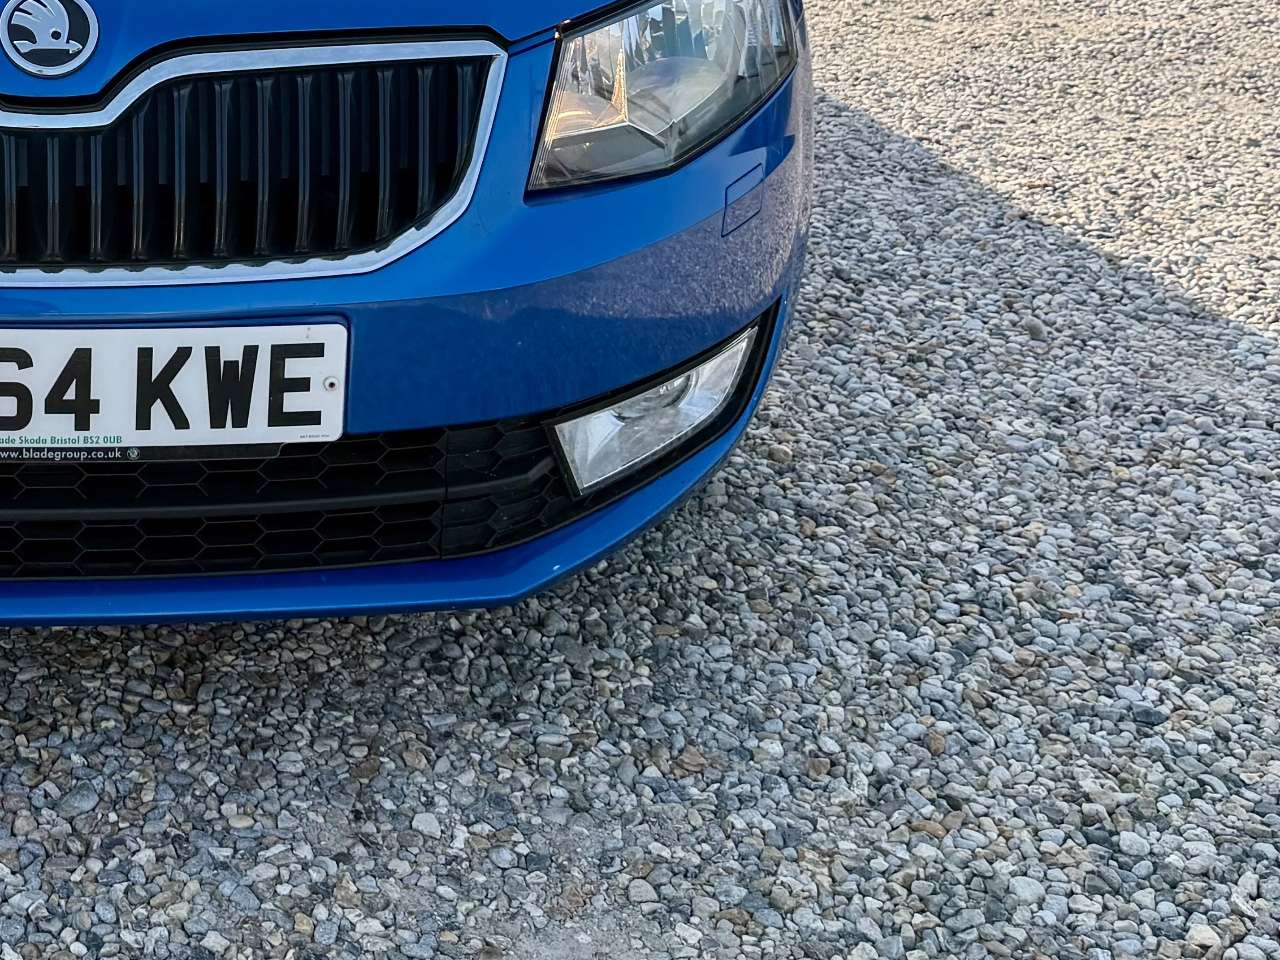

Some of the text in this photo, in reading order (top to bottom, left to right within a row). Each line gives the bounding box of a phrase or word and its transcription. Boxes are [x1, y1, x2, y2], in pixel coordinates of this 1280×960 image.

[135, 342, 325, 432] KWE
[18, 435, 48, 445] Skoda
[50, 435, 80, 445] Bristol
[83, 435, 100, 445] BS2
